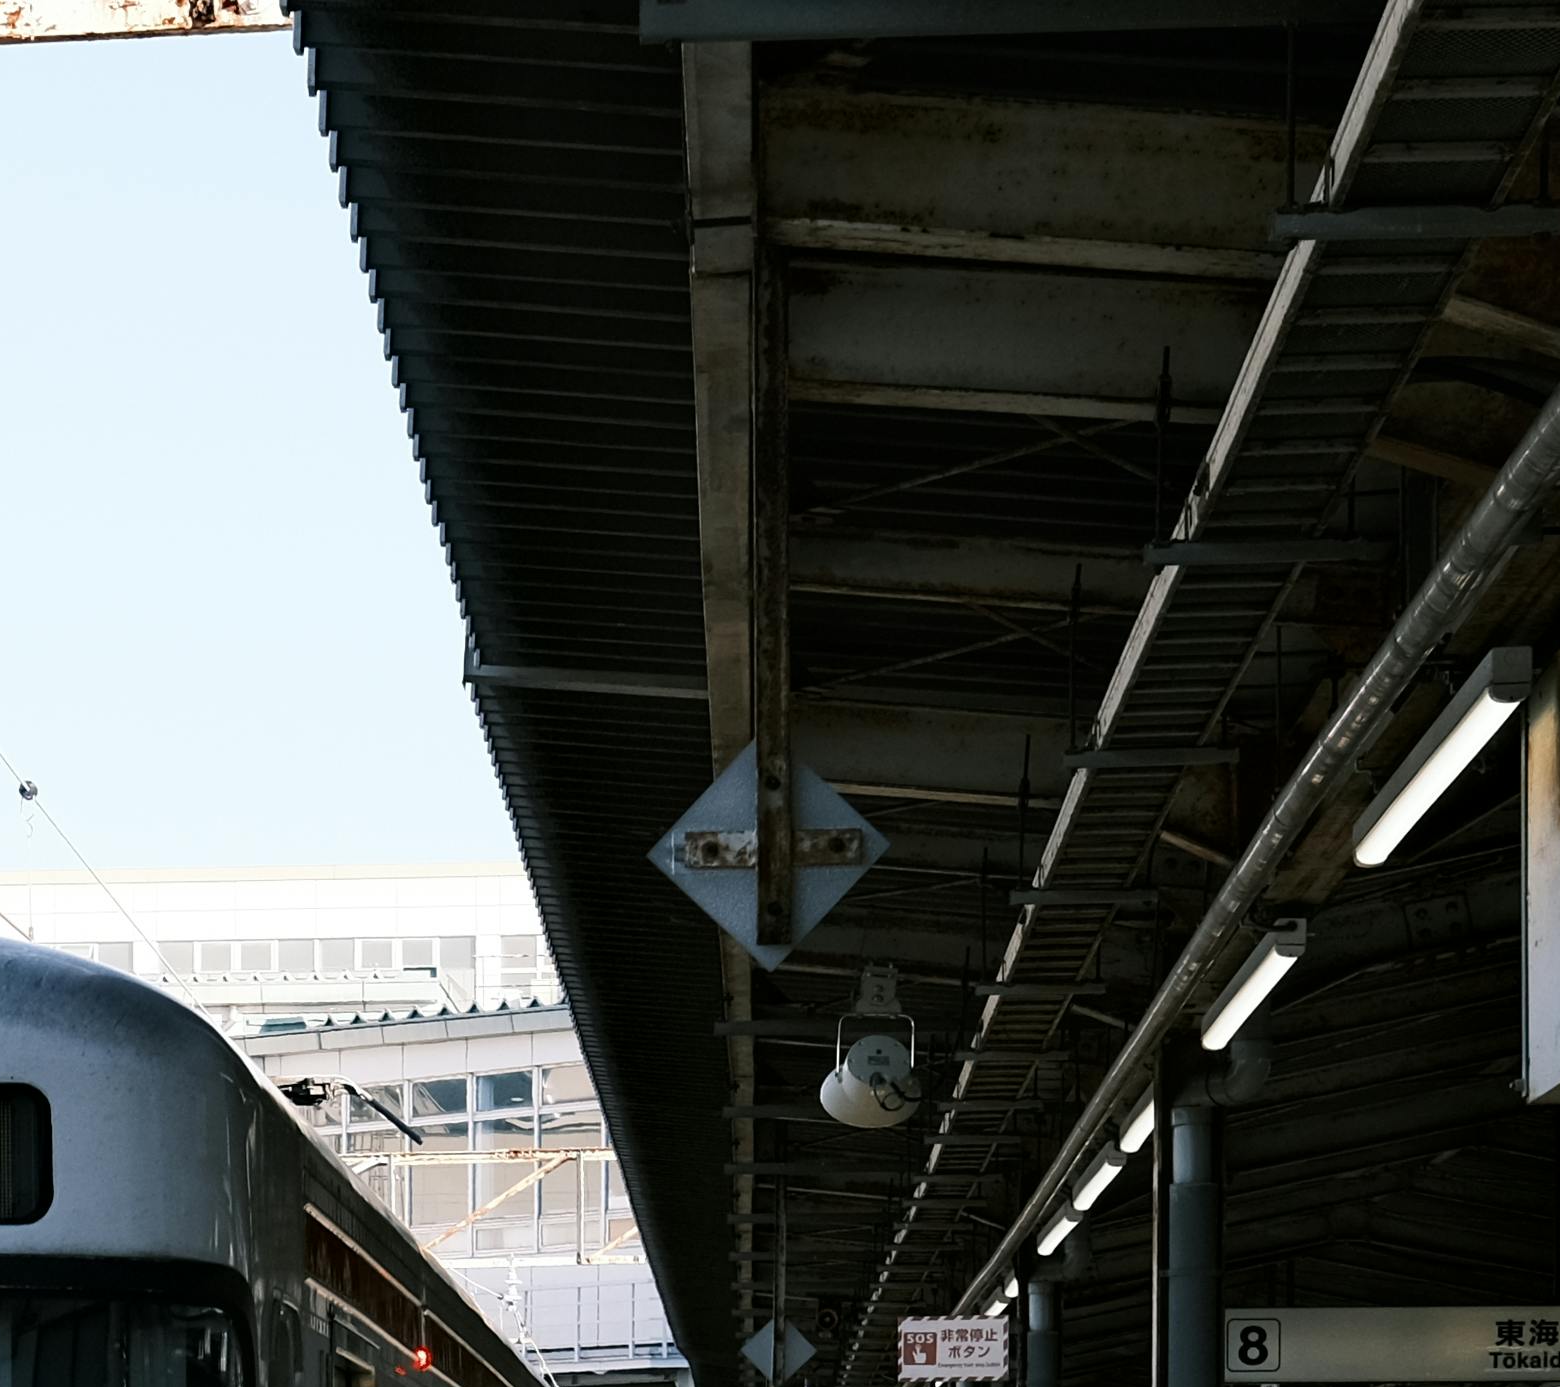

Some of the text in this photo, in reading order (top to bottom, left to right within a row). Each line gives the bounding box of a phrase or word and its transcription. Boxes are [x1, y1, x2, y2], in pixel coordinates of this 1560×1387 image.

[907, 1334, 933, 1344] SOS
[941, 1328, 998, 1342] 非常停止
[948, 1346, 990, 1359] ボタン
[1238, 1326, 1268, 1366] 8
